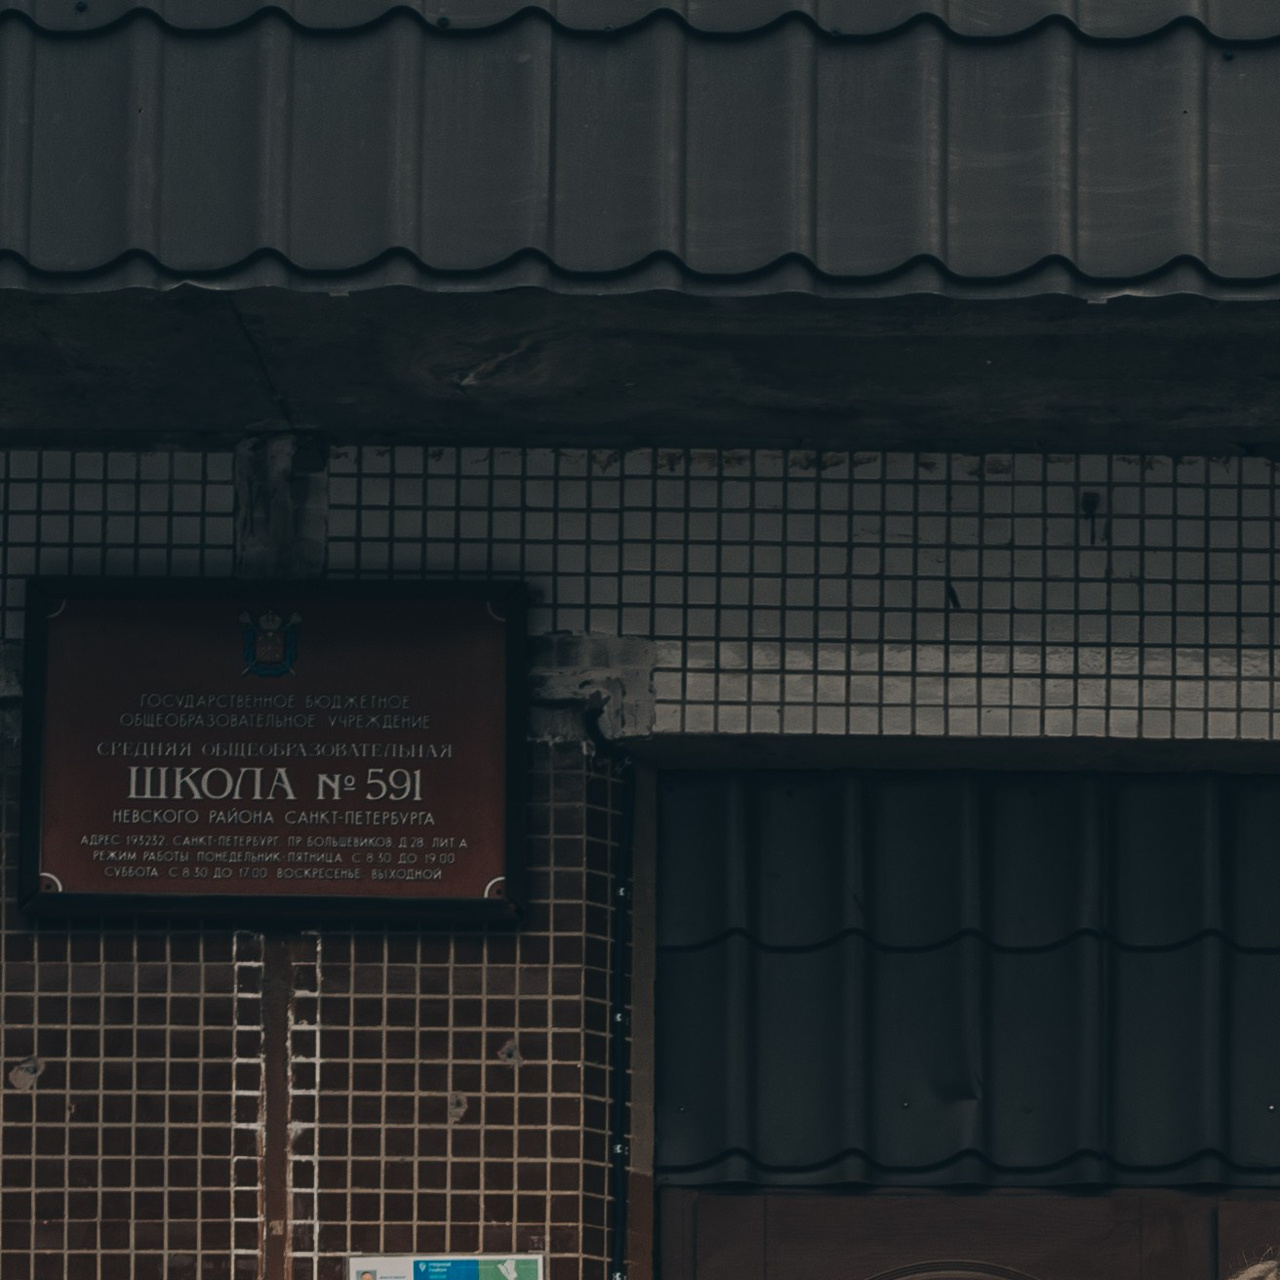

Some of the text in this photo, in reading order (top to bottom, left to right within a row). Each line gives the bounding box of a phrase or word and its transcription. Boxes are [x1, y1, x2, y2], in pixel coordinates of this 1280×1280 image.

[140, 693, 411, 710] ГОСУДАРСТВЕННОЕ БЮДЖЕТНОЕ
[119, 712, 431, 730] ОБЩЕОБРАЗОВАТЕЛЬНОЕ УЧРЕЖДЕНИЕ
[96, 741, 454, 760] СРЕДНЯЯ ОБЩЕОБРАЗОВАТЕЛЬНАЯ
[126, 766, 423, 802] ШКОЛА № 591
[112, 806, 436, 827] НЕВСКОГО РАЙОНА САНКТ-ПЕТЕРБУРГА
[458, 838, 469, 849] А
[92, 850, 138, 862] РЕЖИМ
[351, 852, 362, 864] С
[397, 853, 419, 865] ДО
[104, 866, 160, 878] СУББОТА
[168, 866, 179, 878] С
[213, 867, 234, 880] ДО
[370, 868, 443, 881] ВЫХОДНОЙ
